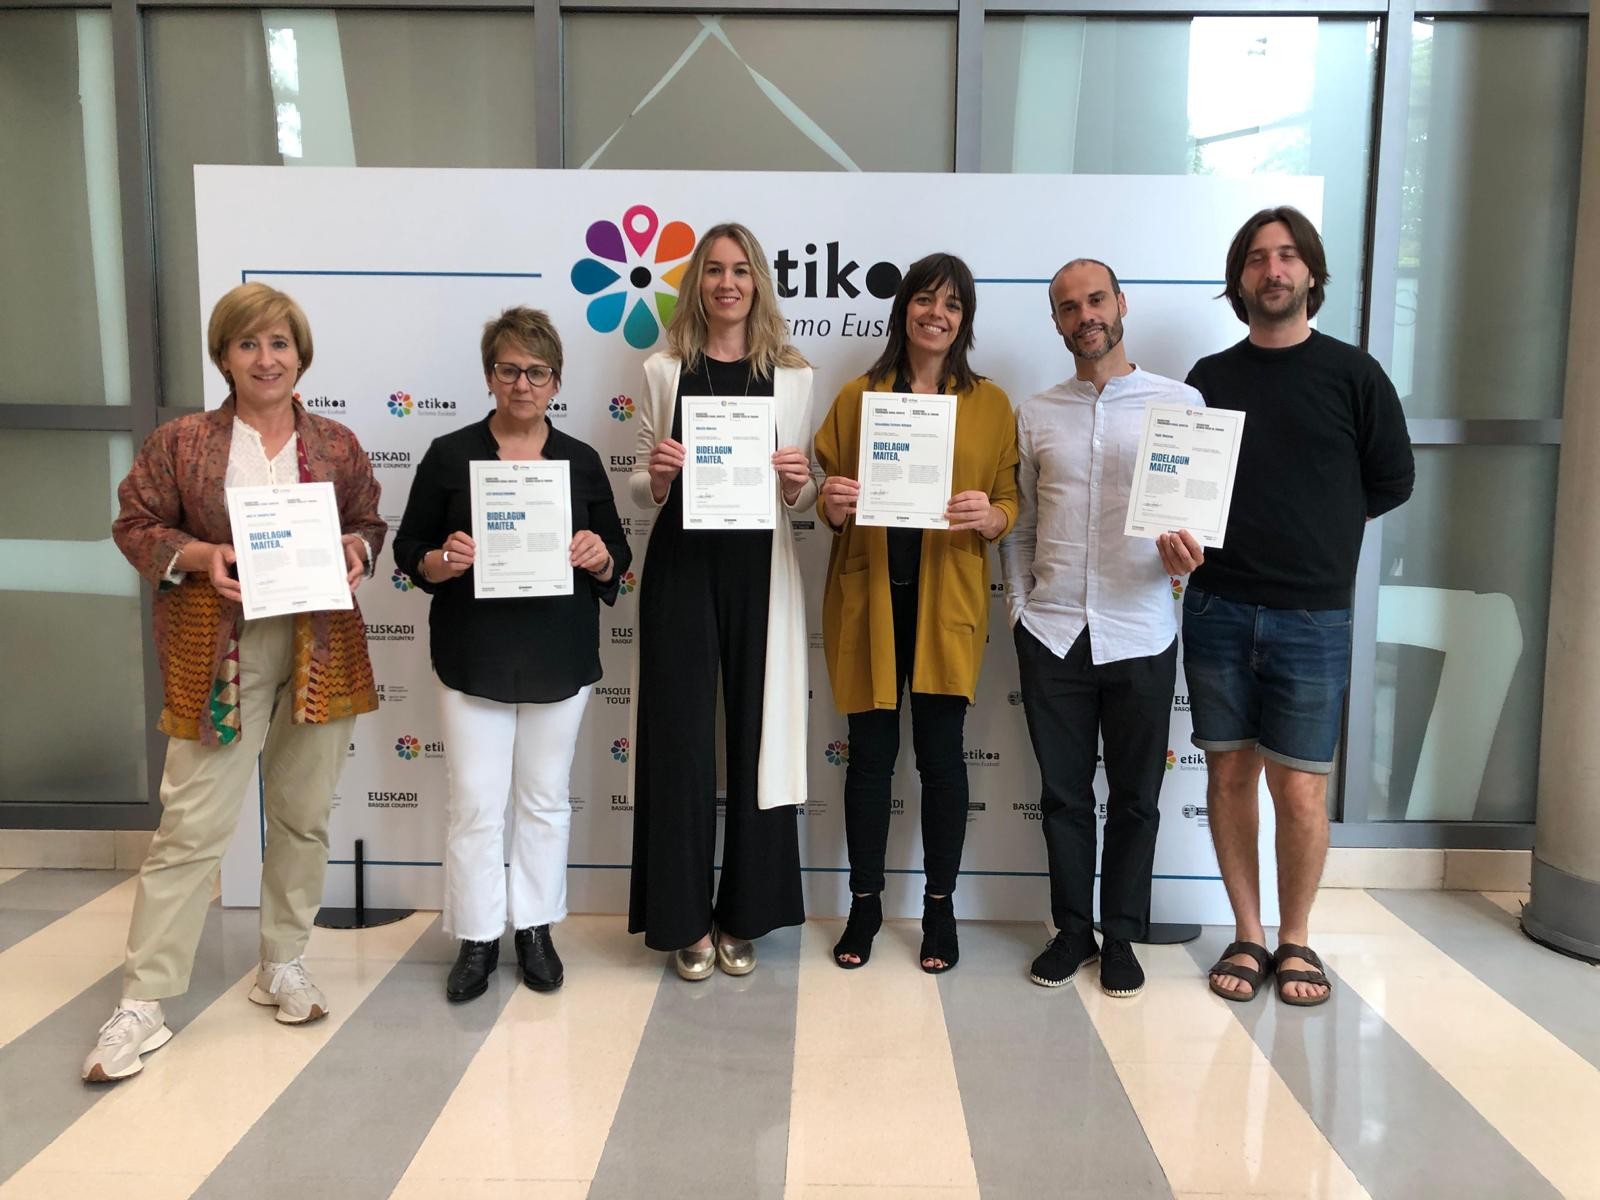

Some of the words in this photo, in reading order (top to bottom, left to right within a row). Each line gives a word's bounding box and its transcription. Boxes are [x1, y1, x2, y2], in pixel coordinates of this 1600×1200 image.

[774, 241, 902, 299] tiko
[307, 396, 346, 407] etikoa
[417, 397, 456, 409] etikoa
[696, 445, 733, 454] BIDELAGUN
[873, 441, 910, 451] BIDELAGUN
[366, 451, 411, 462] USKADI
[1150, 452, 1190, 465] BIDELAGUN
[1149, 462, 1178, 475] MAITEA,
[486, 511, 526, 521] BIDELAGUN
[249, 530, 292, 541] BIDELAGUN
[364, 624, 415, 634] EUSKADI
[1180, 753, 1205, 764] etik
[368, 791, 418, 802] EUSKADI
